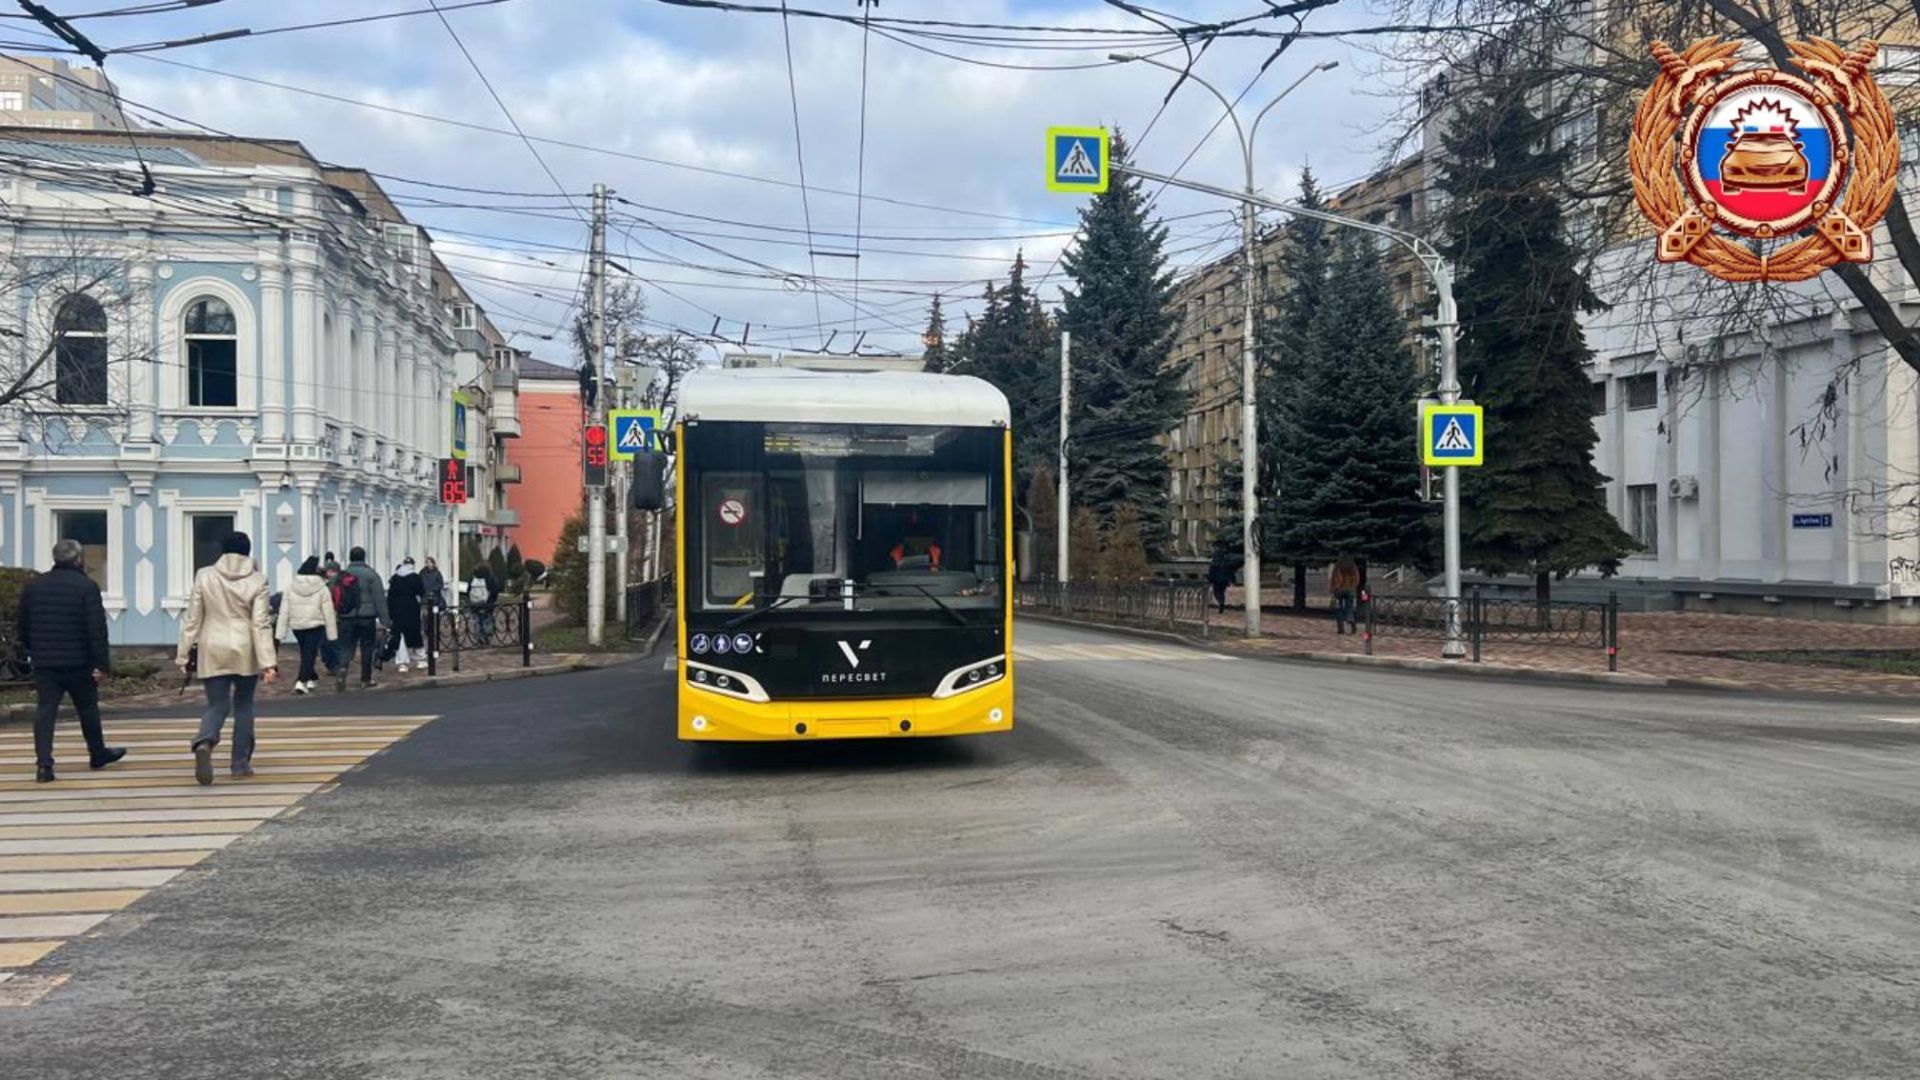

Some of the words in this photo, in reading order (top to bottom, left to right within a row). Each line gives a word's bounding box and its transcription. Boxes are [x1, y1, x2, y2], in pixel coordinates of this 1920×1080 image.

[588, 447, 606, 465] 53
[443, 481, 465, 503] 85
[822, 672, 887, 683] ПЕРЕСВЕТ
